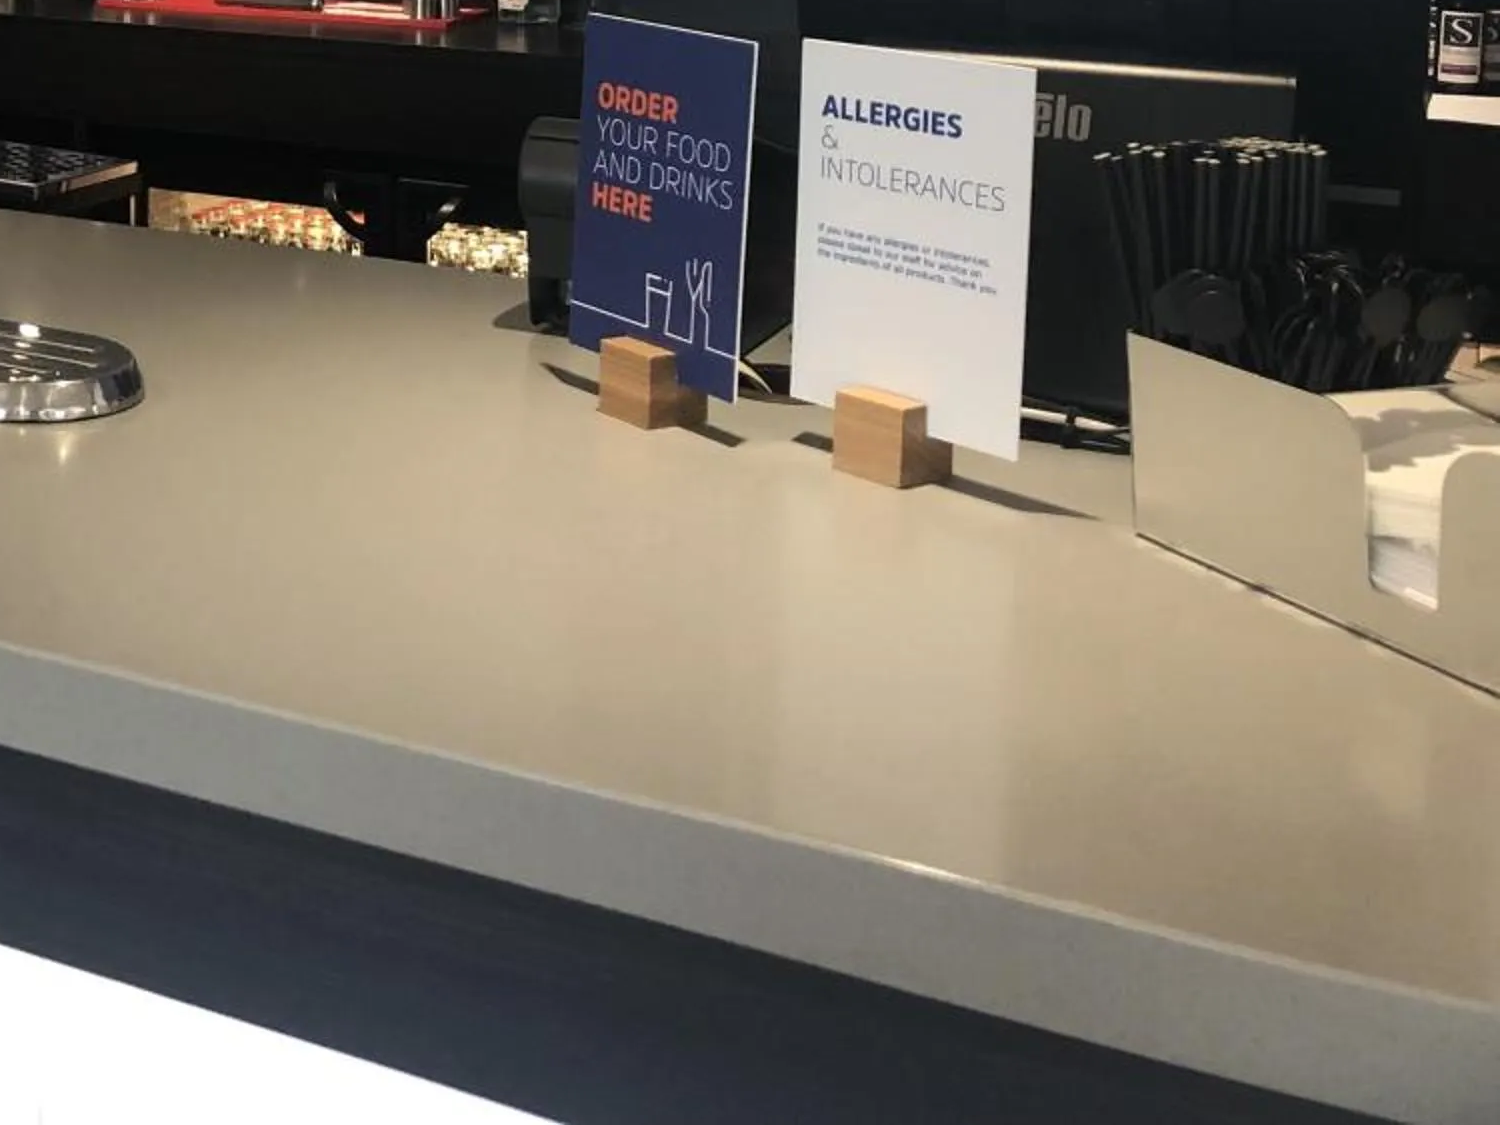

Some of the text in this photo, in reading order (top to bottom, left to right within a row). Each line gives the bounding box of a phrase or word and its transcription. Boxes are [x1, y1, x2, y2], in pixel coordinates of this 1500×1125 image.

[1449, 18, 1474, 44] S
[598, 81, 679, 124] ORDER
[822, 94, 963, 139] ALLERGIES
[598, 115, 731, 172] YOUR FOOD
[821, 124, 839, 150] &
[593, 149, 733, 211] AND DRINKS
[821, 156, 1005, 213] INTOLERANCES
[592, 183, 653, 223] HERE
